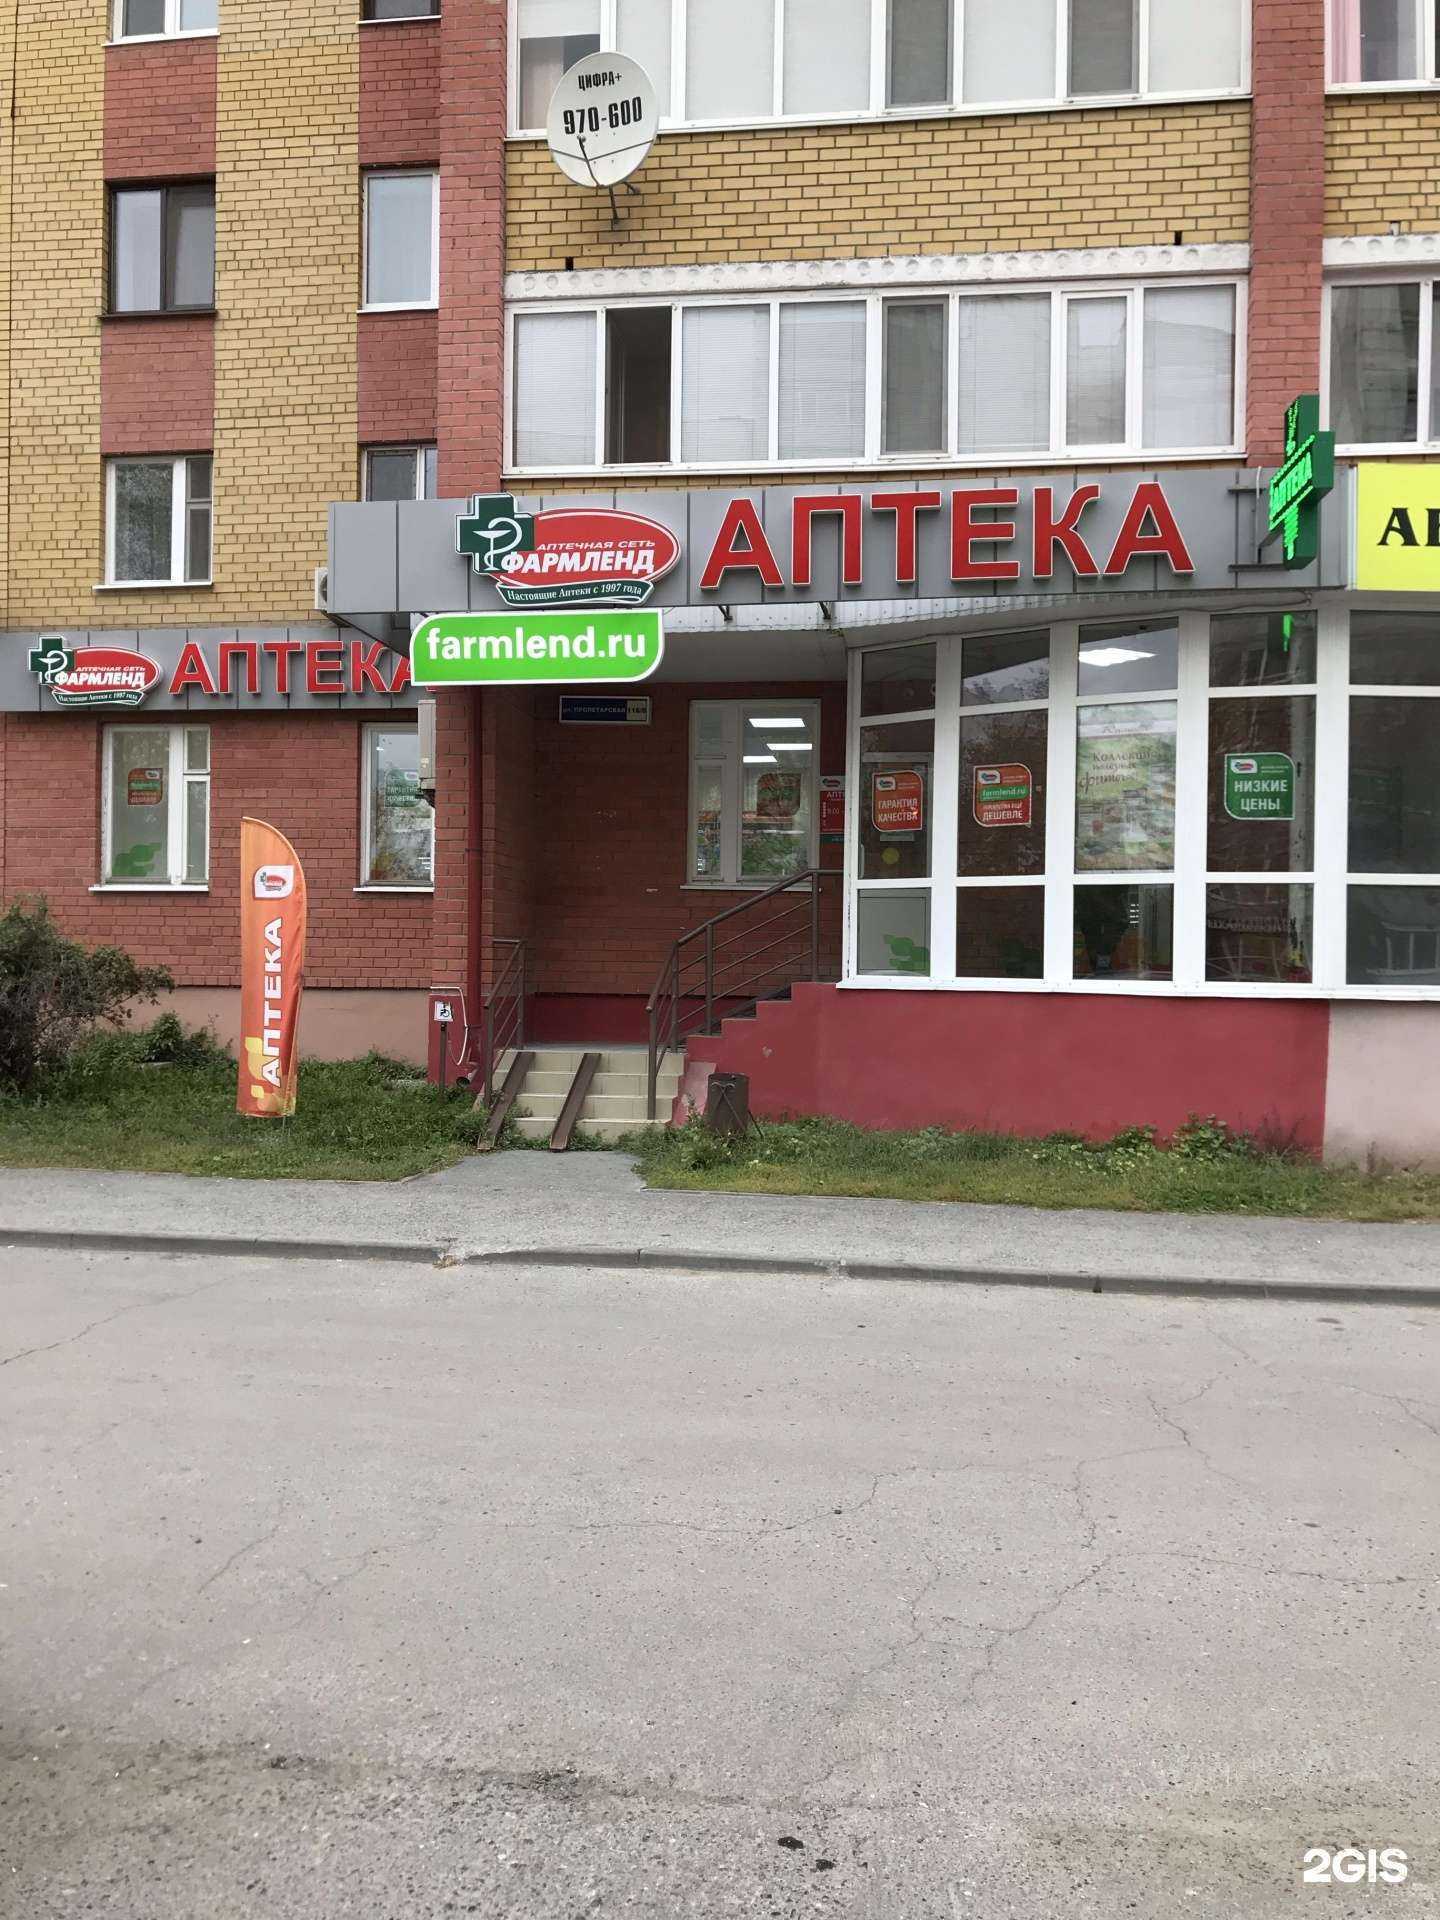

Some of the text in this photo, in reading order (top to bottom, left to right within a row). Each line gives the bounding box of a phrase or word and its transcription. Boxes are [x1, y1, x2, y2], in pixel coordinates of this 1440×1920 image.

[578, 71, 622, 91] ЦИФРА+
[563, 96, 643, 135] 970-600
[699, 481, 1195, 590] АПТЕКА
[536, 540, 655, 551] АПТЕЧНАЯ СЕТЬ
[501, 549, 655, 575] ФАРМЛЕНД
[507, 589, 557, 601] Настоящие
[559, 587, 591, 598] Аптеки
[601, 583, 621, 594] 1997
[623, 585, 642, 596] года
[426, 626, 645, 660] farmlend.ru
[55, 671, 145, 687] ФАРМЛЕНД
[1234, 780, 1288, 792] НИЗКИЕ
[878, 798, 918, 809] ГАРАНТИЯ
[1241, 798, 1280, 812] ЦЕНЫ
[878, 811, 918, 823] КАЧЕСТВА
[983, 810, 1023, 821] ДЕШЕВЛЕ
[262, 917, 282, 1088] АПТЕКА
